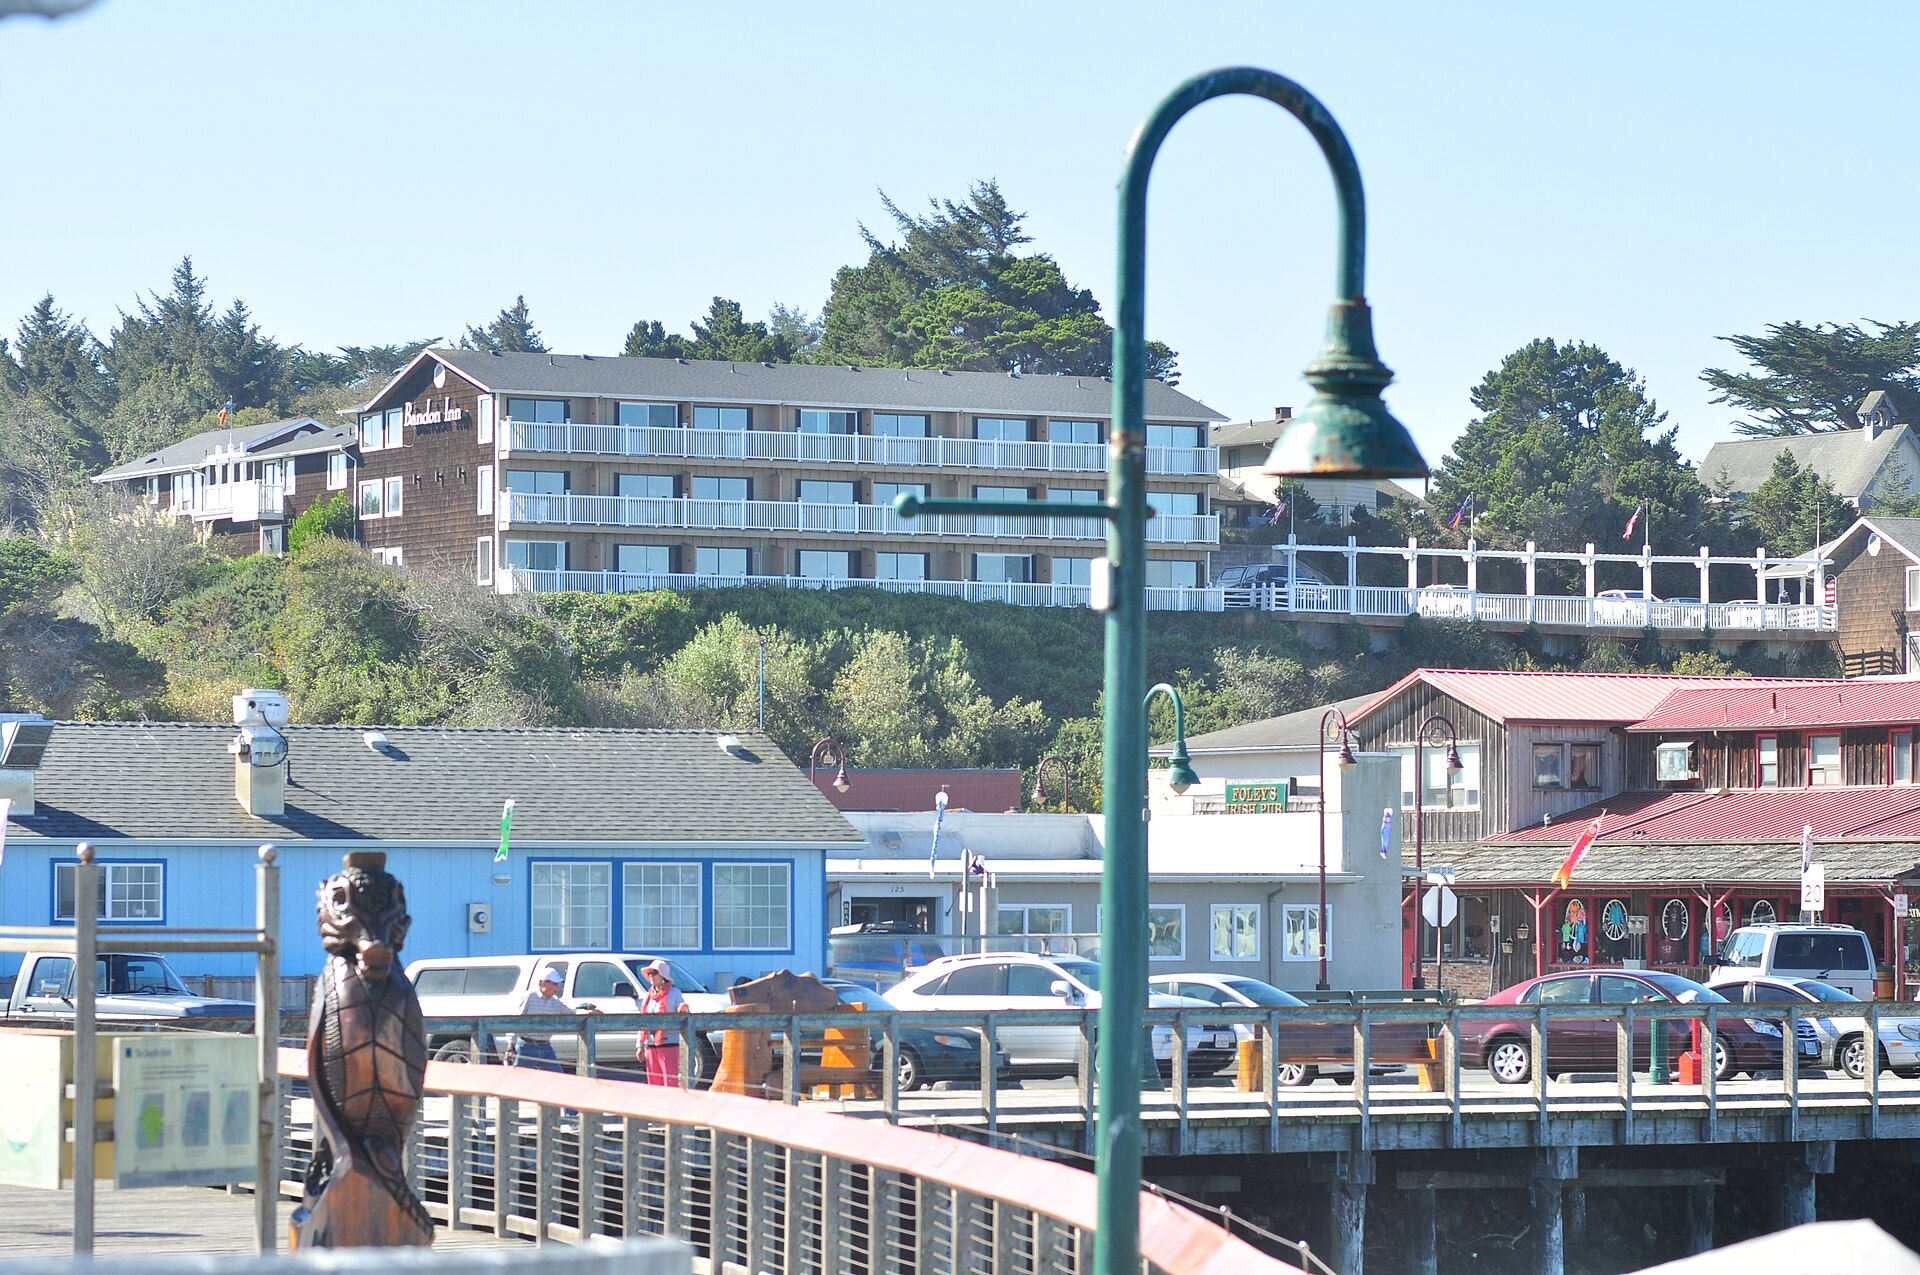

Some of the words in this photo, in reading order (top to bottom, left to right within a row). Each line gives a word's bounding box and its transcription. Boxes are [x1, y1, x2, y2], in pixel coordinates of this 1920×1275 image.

[404, 398, 441, 427] Bandon
[443, 396, 461, 422] Inn
[1232, 786, 1277, 802] FOLEY'S
[1226, 803, 1257, 814] IRISH
[1260, 803, 1283, 814] PUB
[1804, 884, 1821, 902] 20
